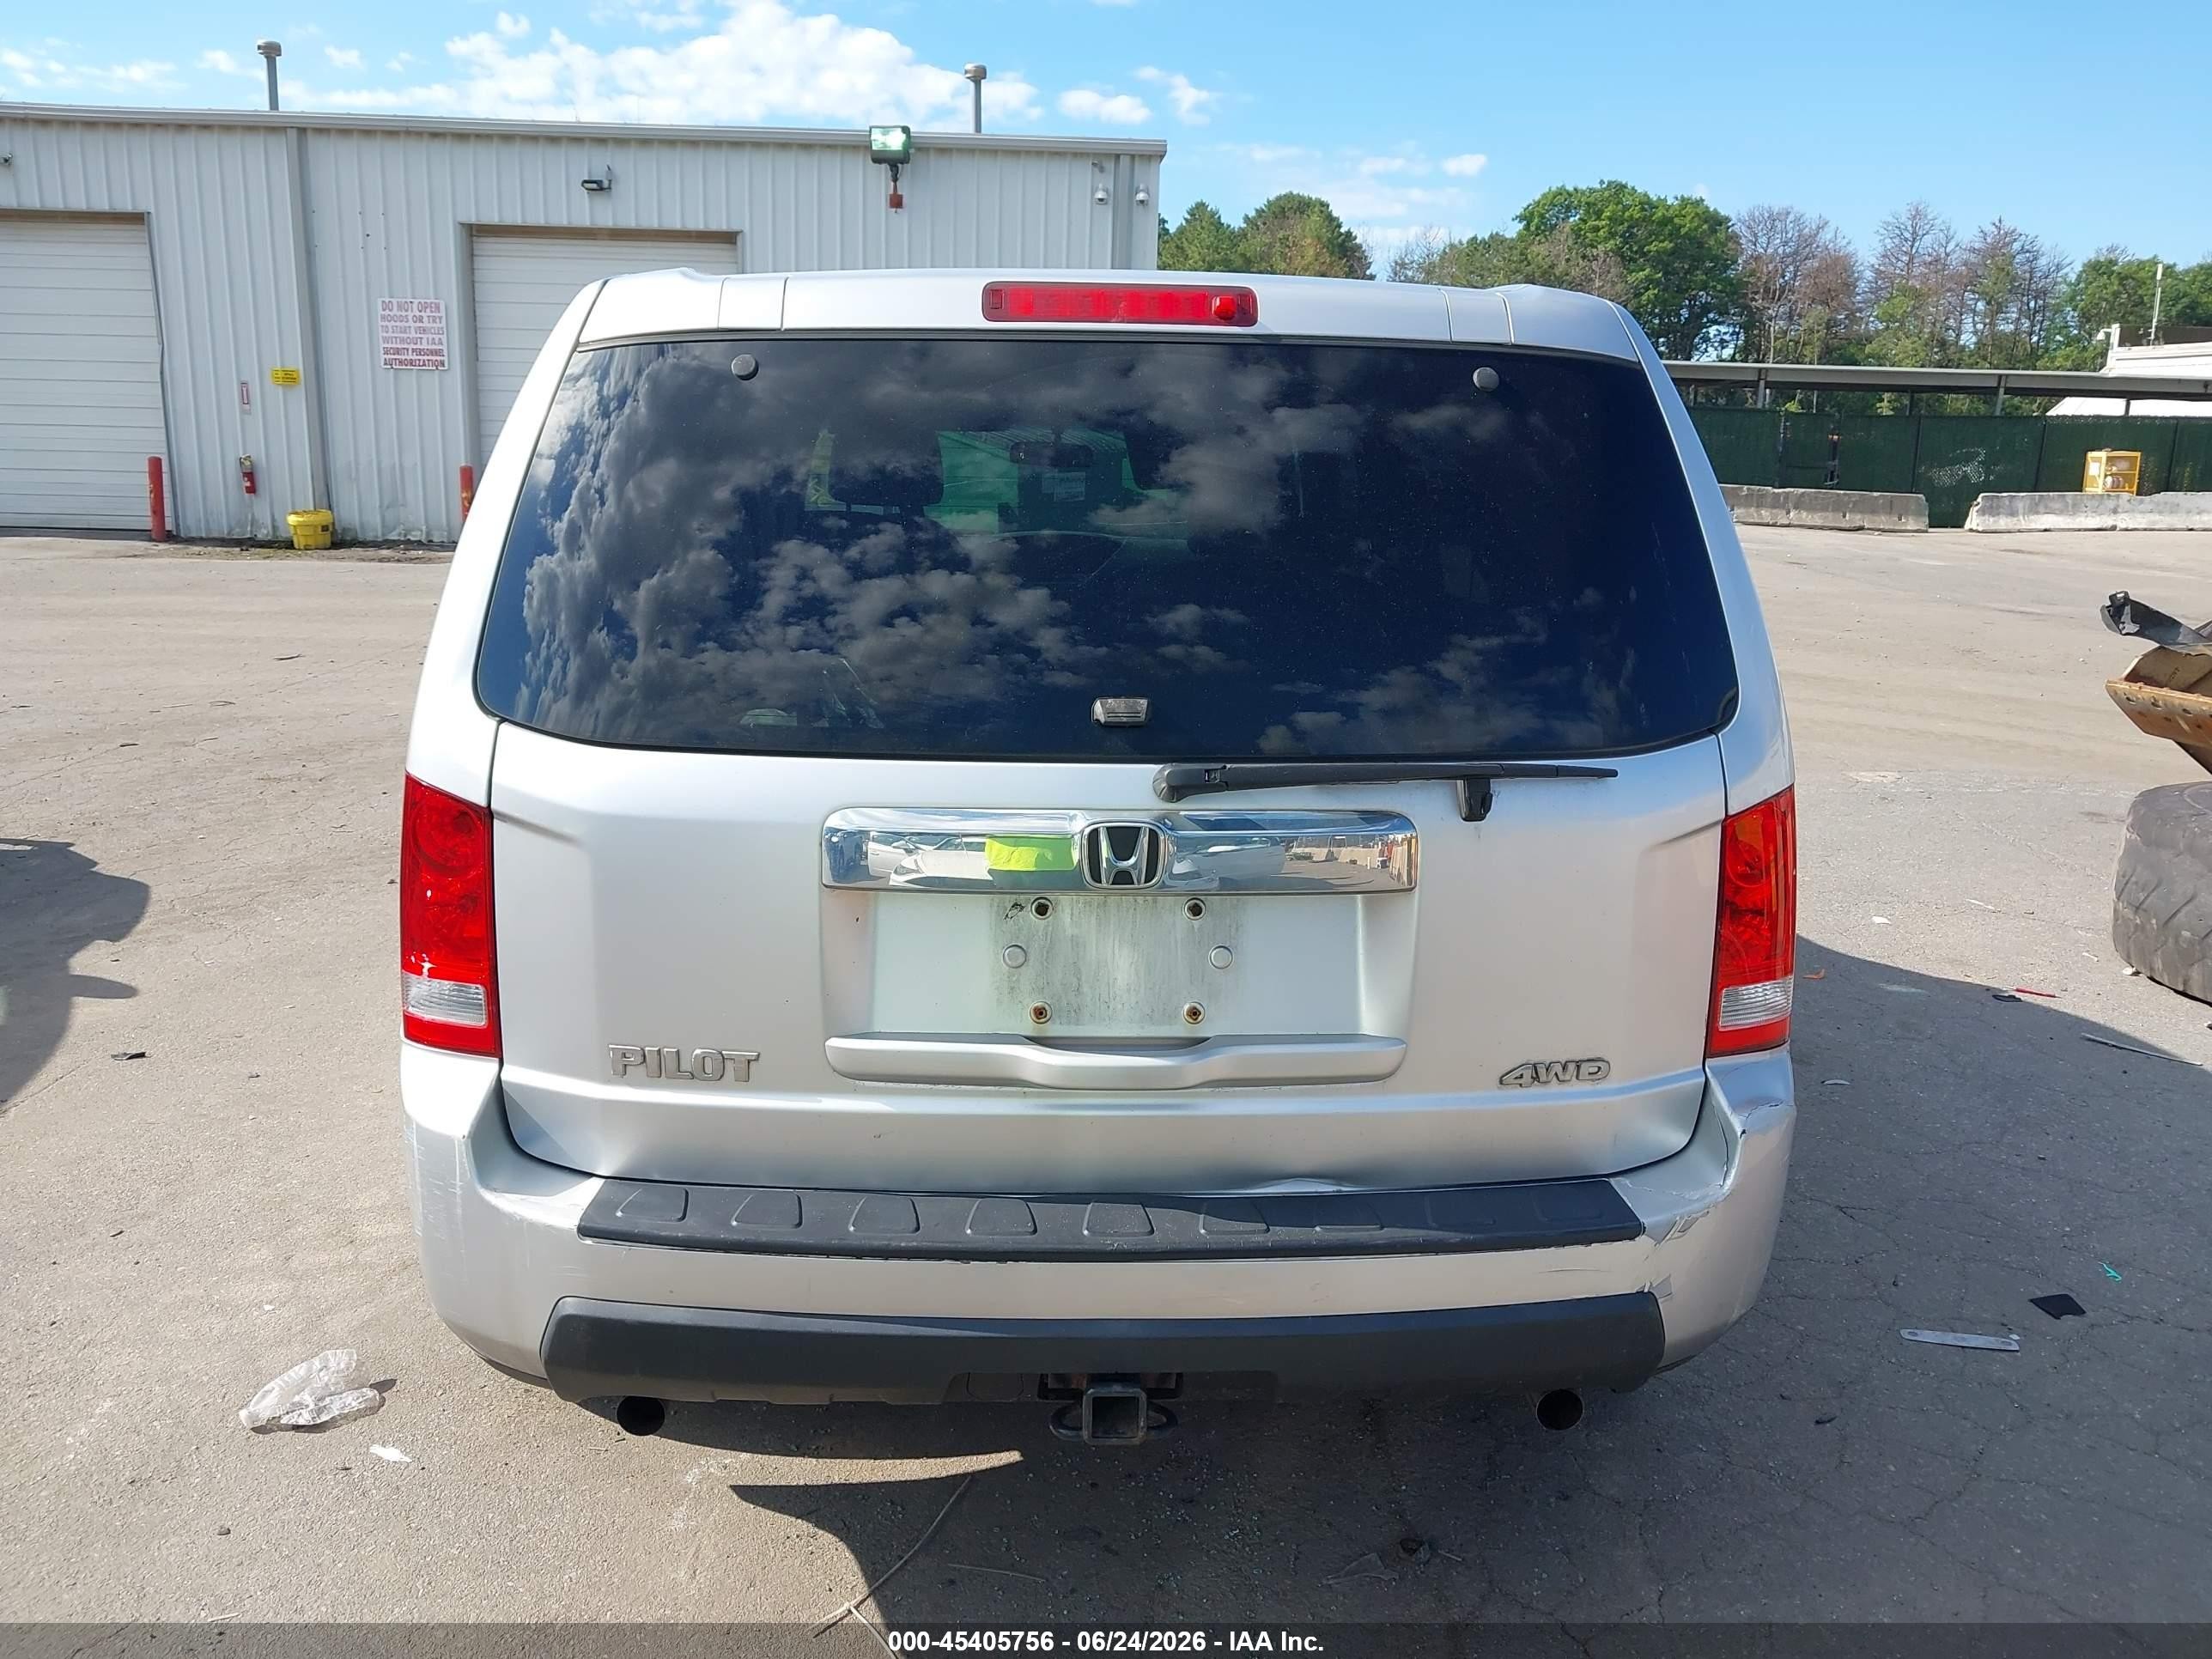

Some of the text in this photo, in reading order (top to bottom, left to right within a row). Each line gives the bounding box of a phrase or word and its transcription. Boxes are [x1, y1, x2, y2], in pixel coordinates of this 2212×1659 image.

[381, 301, 441, 313] DO NOT OPEN
[380, 314, 443, 325] HOODS OR TRY
[380, 325, 445, 336] TO START VEHICLES
[381, 336, 444, 346] WITHOUT IAA
[383, 347, 446, 357] SECURITY PERSONNEL
[383, 358, 446, 368] AUTHORIZATION
[608, 1043, 760, 1082] PILOT
[1498, 1058, 1611, 1088] 4WD
